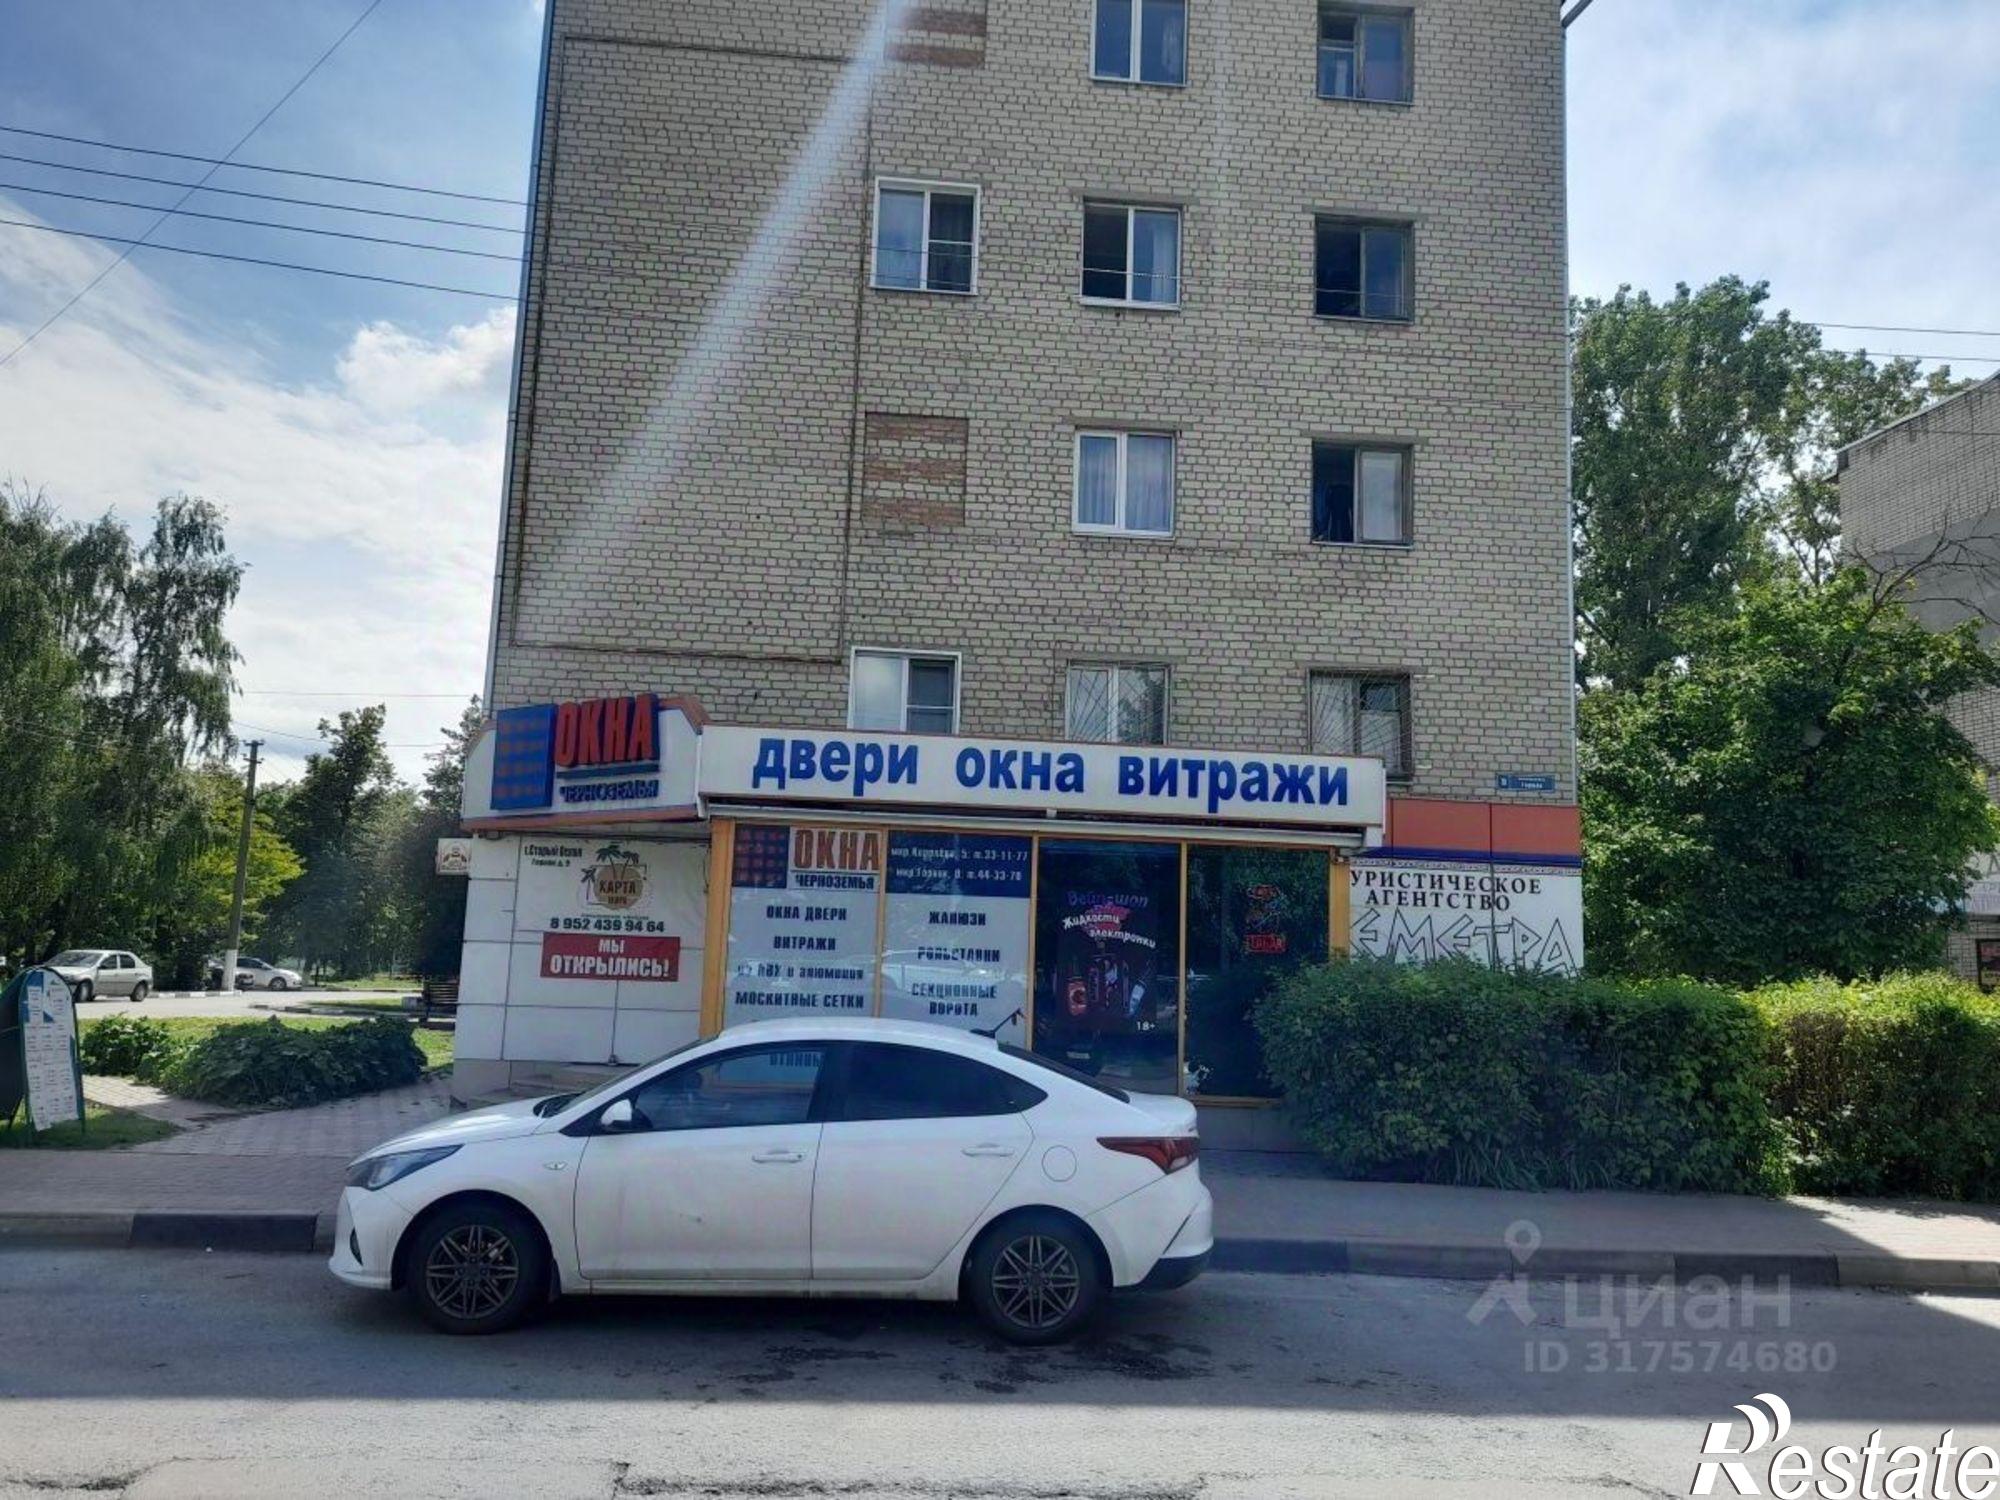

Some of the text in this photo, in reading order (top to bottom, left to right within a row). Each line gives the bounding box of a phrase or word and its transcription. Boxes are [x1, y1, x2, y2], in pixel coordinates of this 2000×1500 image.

[554, 694, 660, 767] ОКНА
[752, 738, 1348, 813] двери окна витражи
[559, 779, 659, 802] ЧЕРНОЗЕМЬЯ
[794, 829, 880, 870] ОКНА
[795, 873, 875, 890] ЧЕРНОЗЕМЬЯ
[1365, 888, 1511, 912] АГЕНТСТВО
[766, 905, 847, 922] ОКНА ДВЕРИ
[929, 910, 986, 926] ЖАЛЮЗИ
[550, 917, 665, 933] 8 952 439 94 64
[598, 938, 625, 953] МЫ
[773, 935, 836, 951] ВИТРАЖИ
[917, 946, 1000, 963] РОЛЬСТАВНИ
[549, 956, 670, 977] ОТКРЫЛИСЬ!
[787, 966, 795, 978] и
[911, 982, 997, 999] СЕКЦИОННЫЕ
[735, 991, 864, 1009] МОСКИТНЫЕ СЕТКИ
[929, 1001, 978, 1016] ВОРОТА
[1136, 1020, 1156, 1031] 18+
